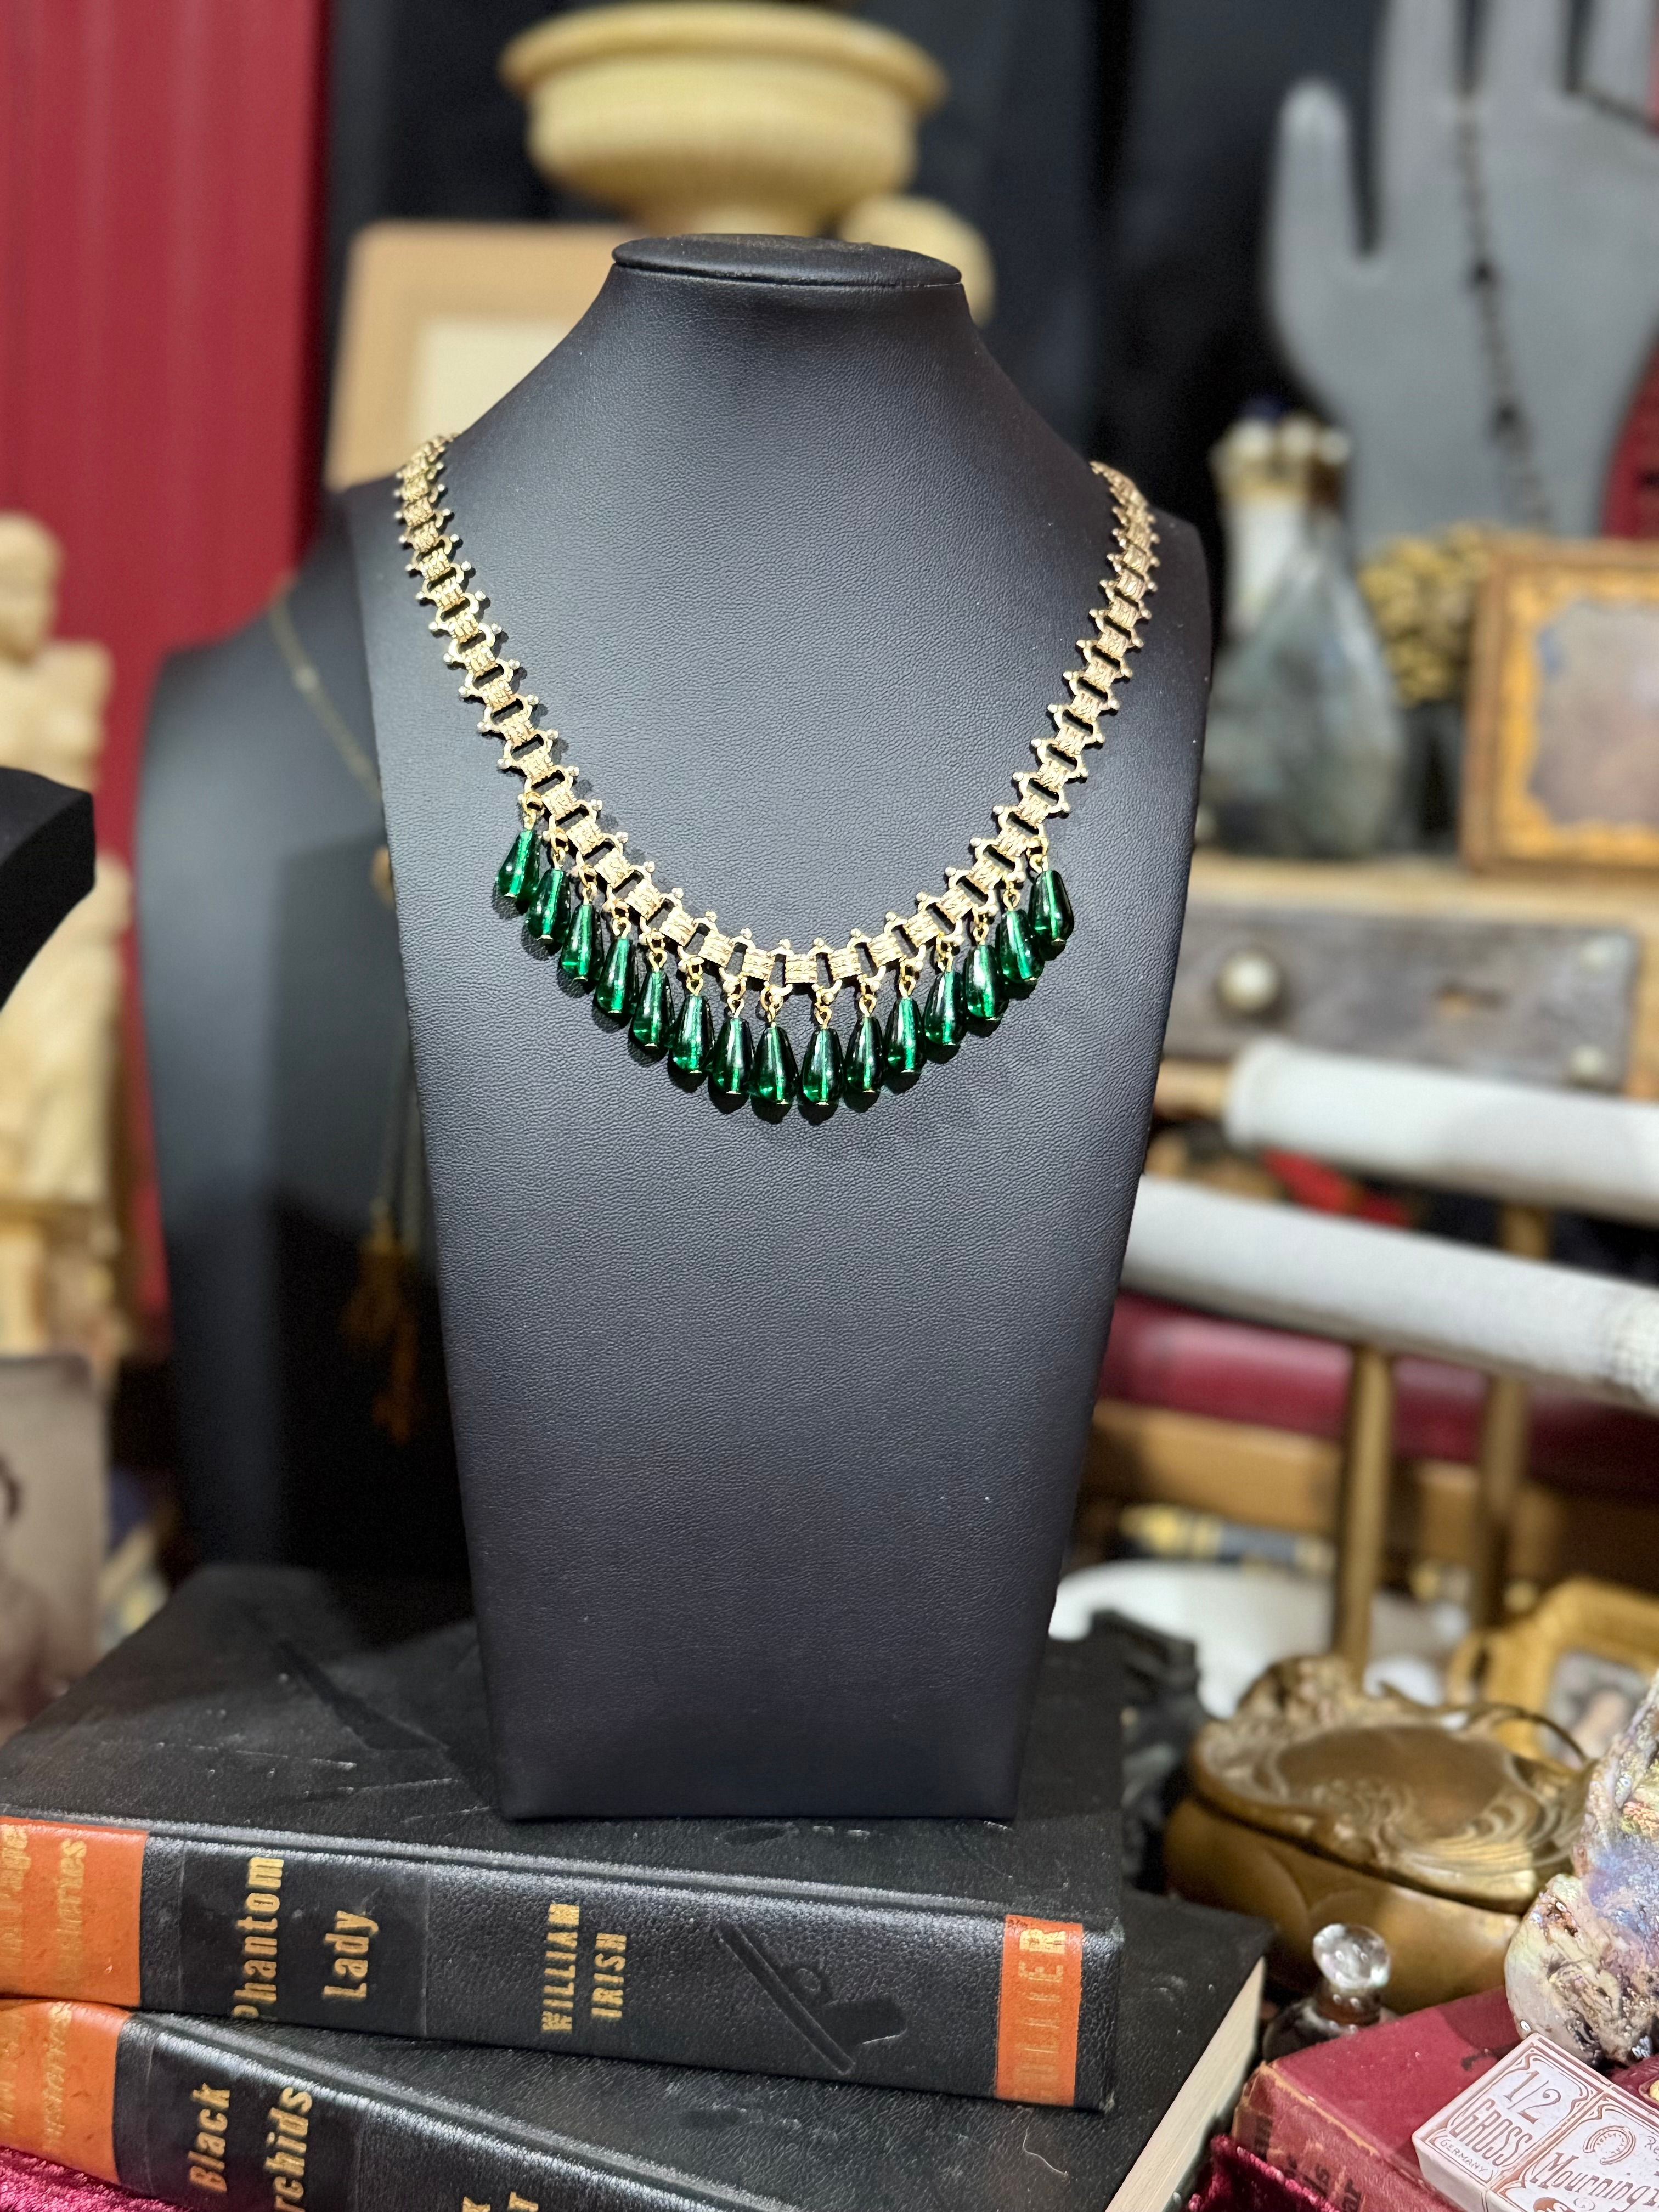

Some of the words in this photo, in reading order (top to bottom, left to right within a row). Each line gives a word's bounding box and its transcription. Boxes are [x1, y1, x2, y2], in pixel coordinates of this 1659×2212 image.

[323, 1910, 379, 2000] Lady
[541, 1903, 580, 2033] WILLIAM
[591, 1933, 627, 2019] IRISH
[188, 2084, 230, 2193] Black
[1449, 2098, 1533, 2166] GROSS
[1503, 2070, 1561, 2124] 1/2
[264, 2087, 312, 2212] rchids
[1440, 2138, 1488, 2172] GERMANY
[1530, 2152, 1651, 2212] Mourning
